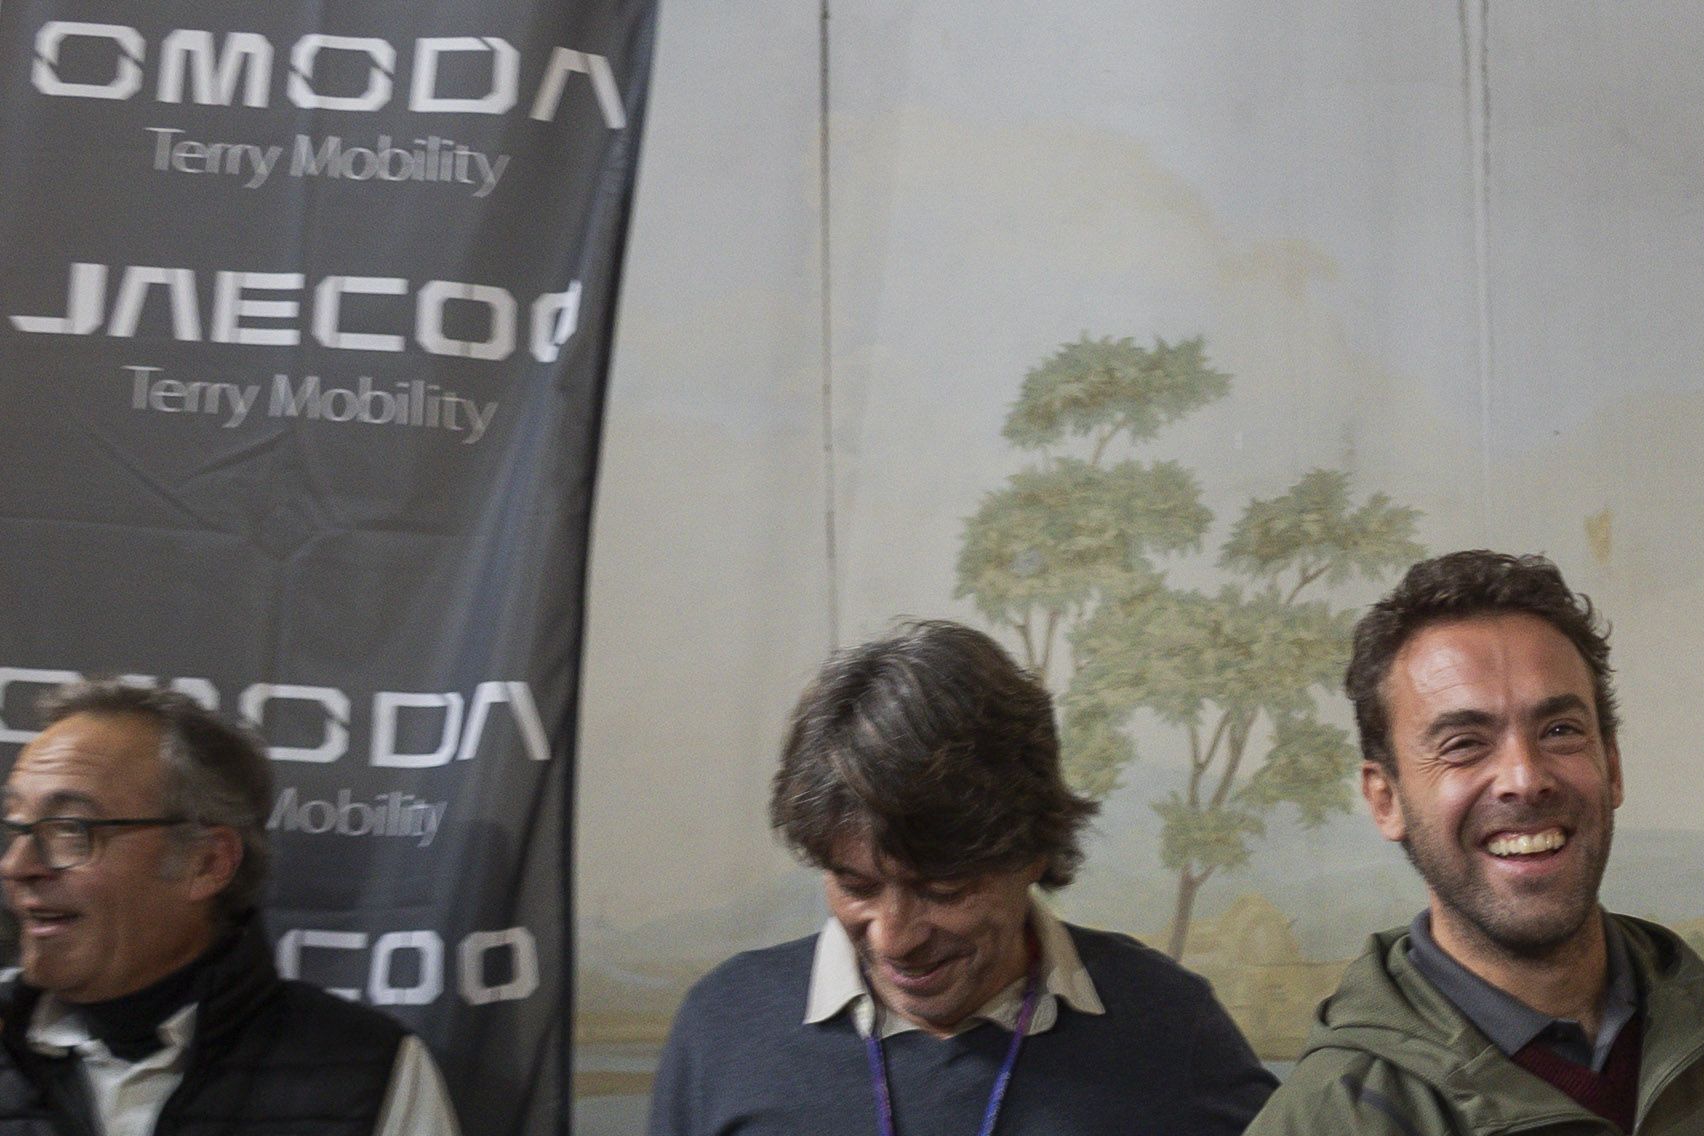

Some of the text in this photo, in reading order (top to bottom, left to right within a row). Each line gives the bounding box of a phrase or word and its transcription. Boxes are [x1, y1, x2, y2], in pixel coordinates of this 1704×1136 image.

[31, 20, 627, 130] OMODA
[144, 126, 511, 198] Terry Mobility
[121, 365, 499, 445] Terry Mobility
[0, 666, 551, 768] OODA
[277, 926, 540, 1006] COO
